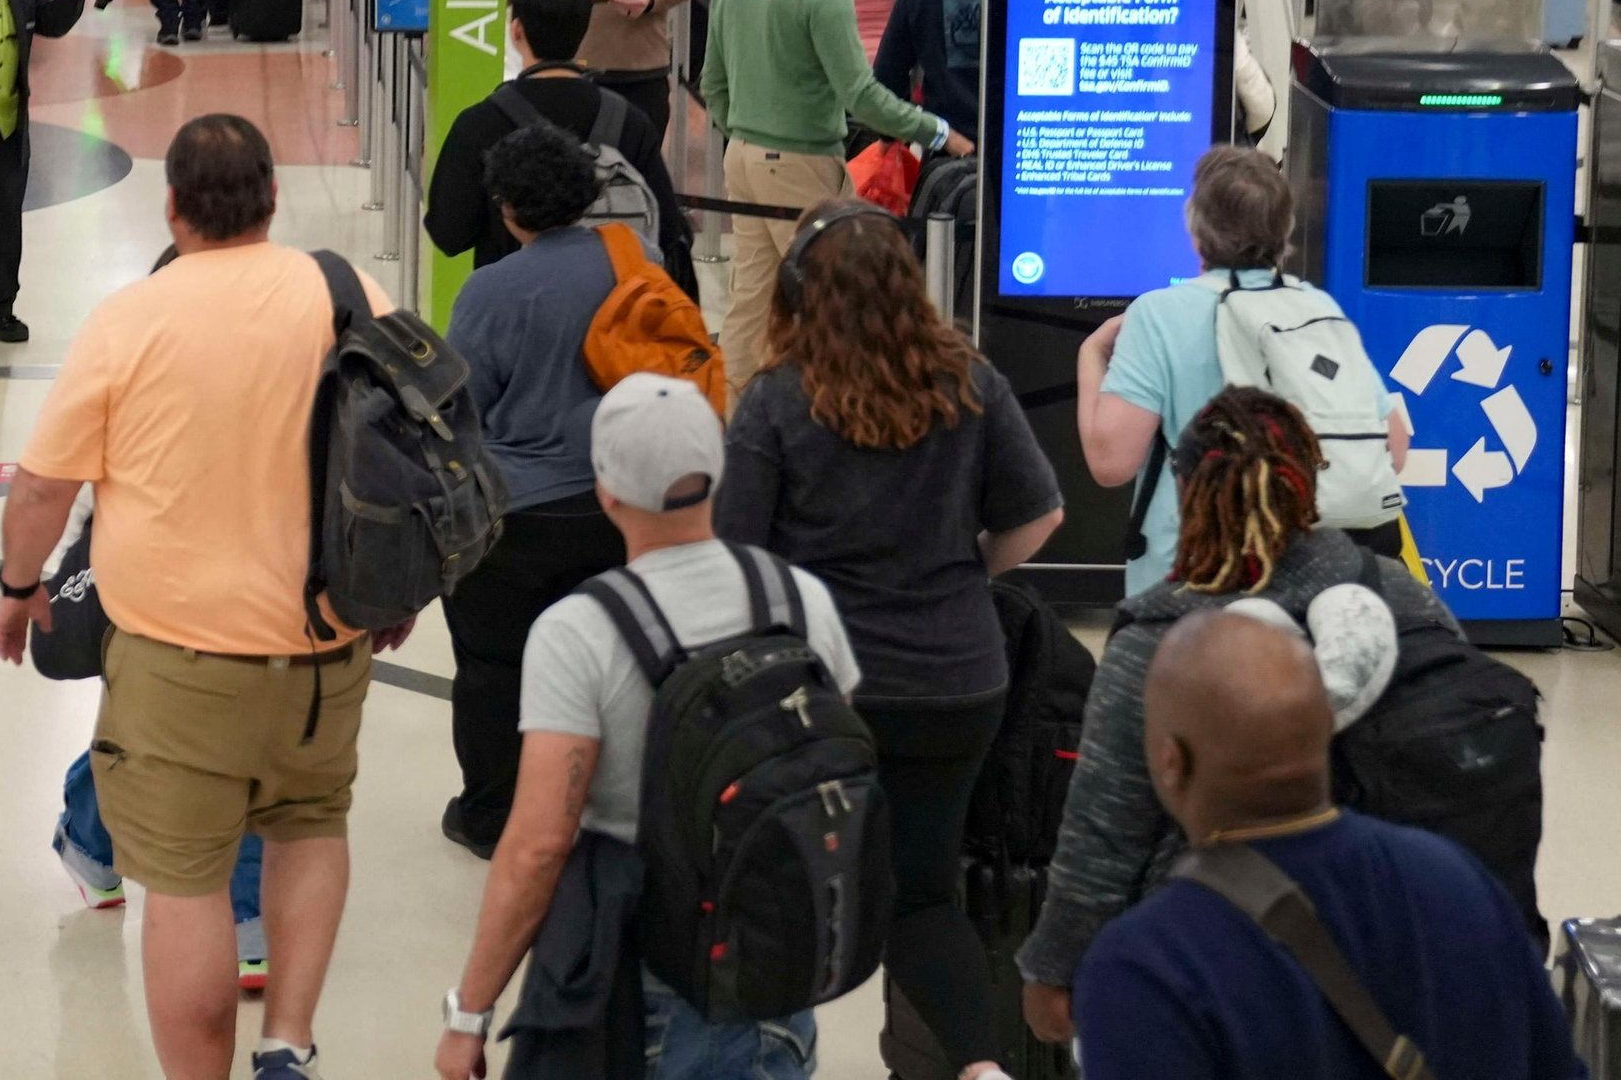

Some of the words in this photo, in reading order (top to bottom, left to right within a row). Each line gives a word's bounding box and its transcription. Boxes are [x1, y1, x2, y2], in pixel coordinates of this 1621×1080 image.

[1043, 6, 1062, 24] of
[1064, 6, 1179, 24] Identification?
[1080, 42, 1104, 55] Scan
[1106, 42, 1123, 54] the
[1140, 42, 1165, 54] code
